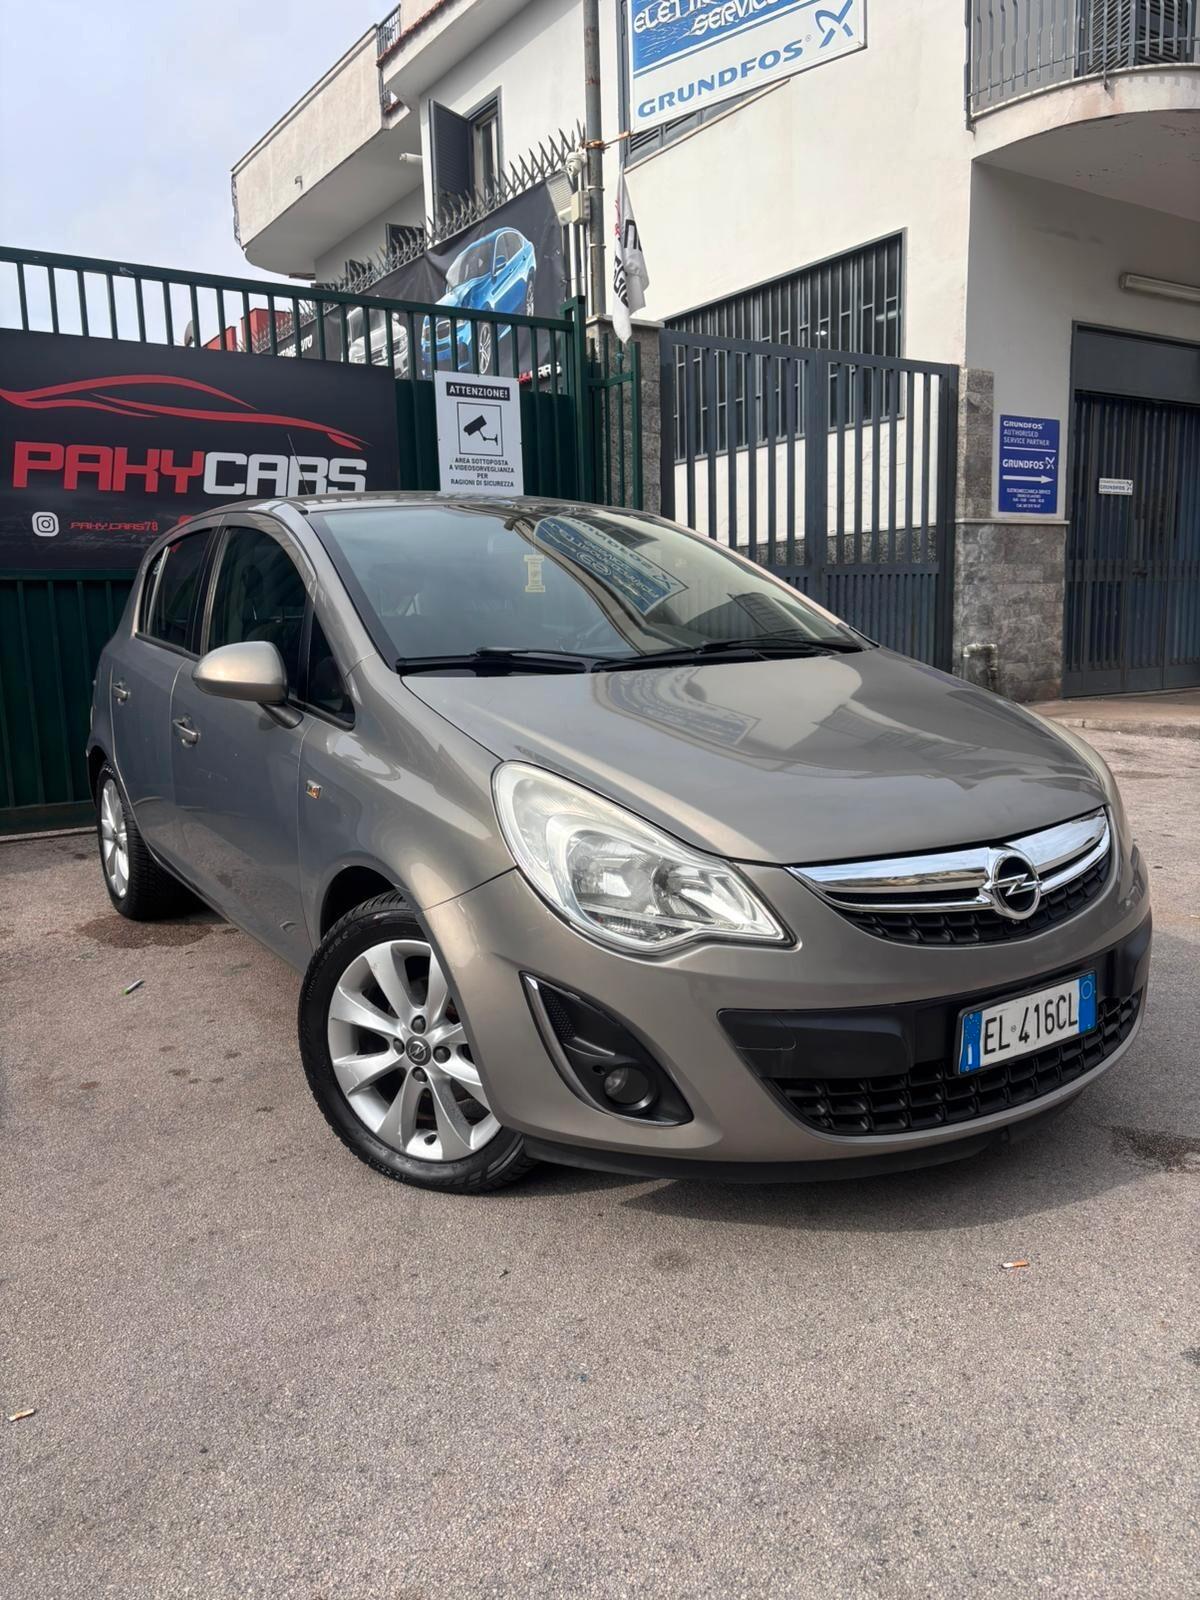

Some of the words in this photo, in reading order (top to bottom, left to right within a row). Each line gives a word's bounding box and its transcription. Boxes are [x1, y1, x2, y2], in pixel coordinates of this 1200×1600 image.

[633, 0, 717, 33] ELET
[690, 0, 778, 35] SERVI
[637, 39, 804, 118] GRUNDFOS
[449, 385, 508, 399] ATTENZIONE!
[1003, 420, 1043, 430] GRUNDFOS
[1003, 429, 1039, 438] AUTHORISED
[1003, 436, 1025, 445] SERVICE
[1026, 438, 1050, 447] PARTNER
[471, 458, 509, 466] SOTTOPOSTA
[1002, 458, 1044, 470] GRUNDFOS
[12, 441, 367, 497] PAKYCARS
[455, 464, 515, 473] VIDEOSORVEGLIANZA
[450, 478, 475, 487] RAGIONI
[483, 480, 515, 488] SICUREZZA
[983, 1014, 1011, 1056] EL
[1018, 991, 1078, 1044] 416CL
